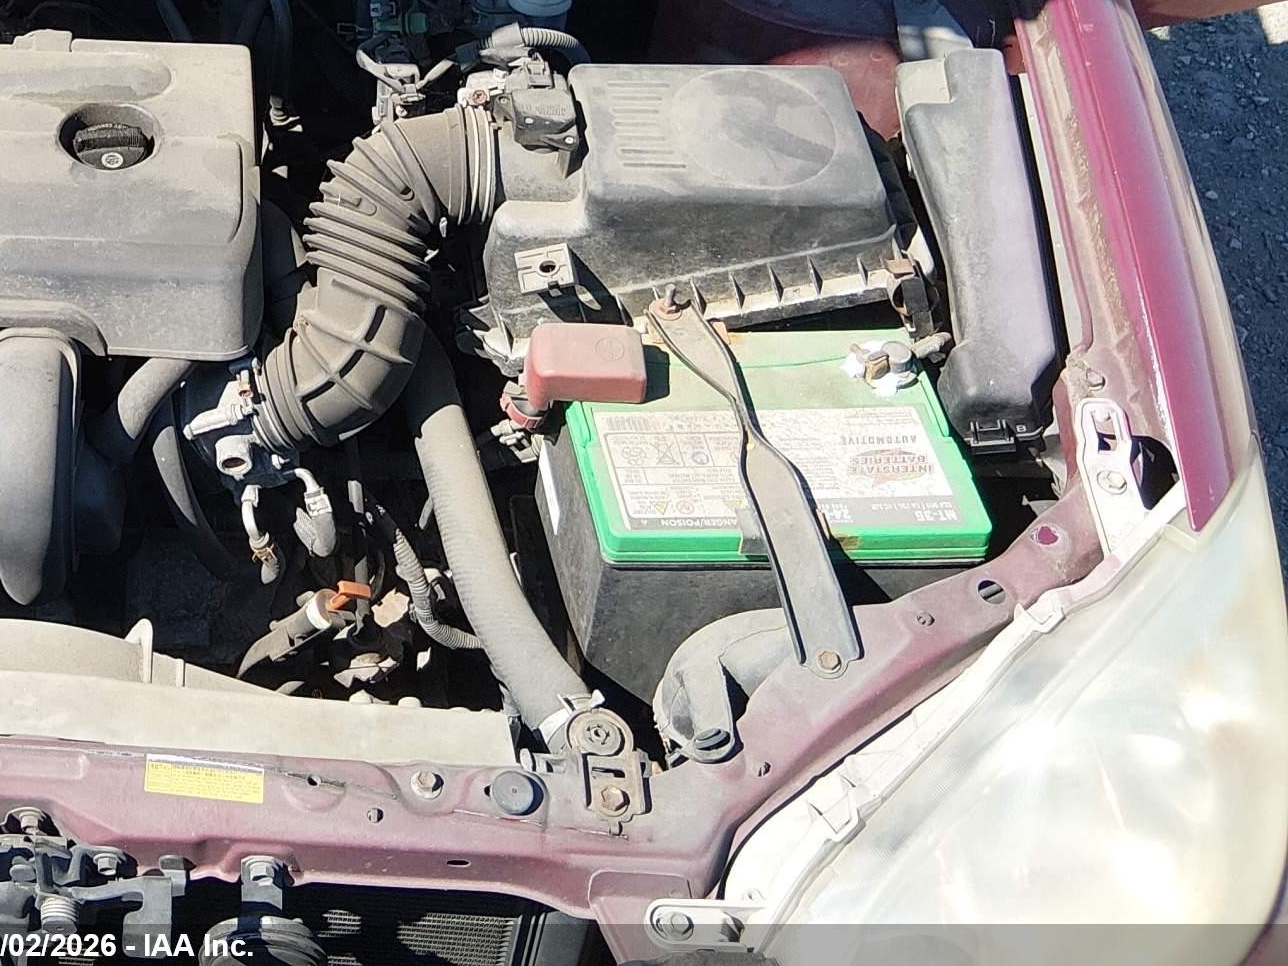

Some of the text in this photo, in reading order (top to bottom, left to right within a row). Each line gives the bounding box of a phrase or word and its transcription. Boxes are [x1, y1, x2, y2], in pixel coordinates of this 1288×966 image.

[839, 435, 917, 446] AUTOMOTIVE
[849, 454, 928, 465] BATTERIES
[847, 464, 935, 476] INTERSTATE
[660, 518, 738, 528] ANGER/POISON
